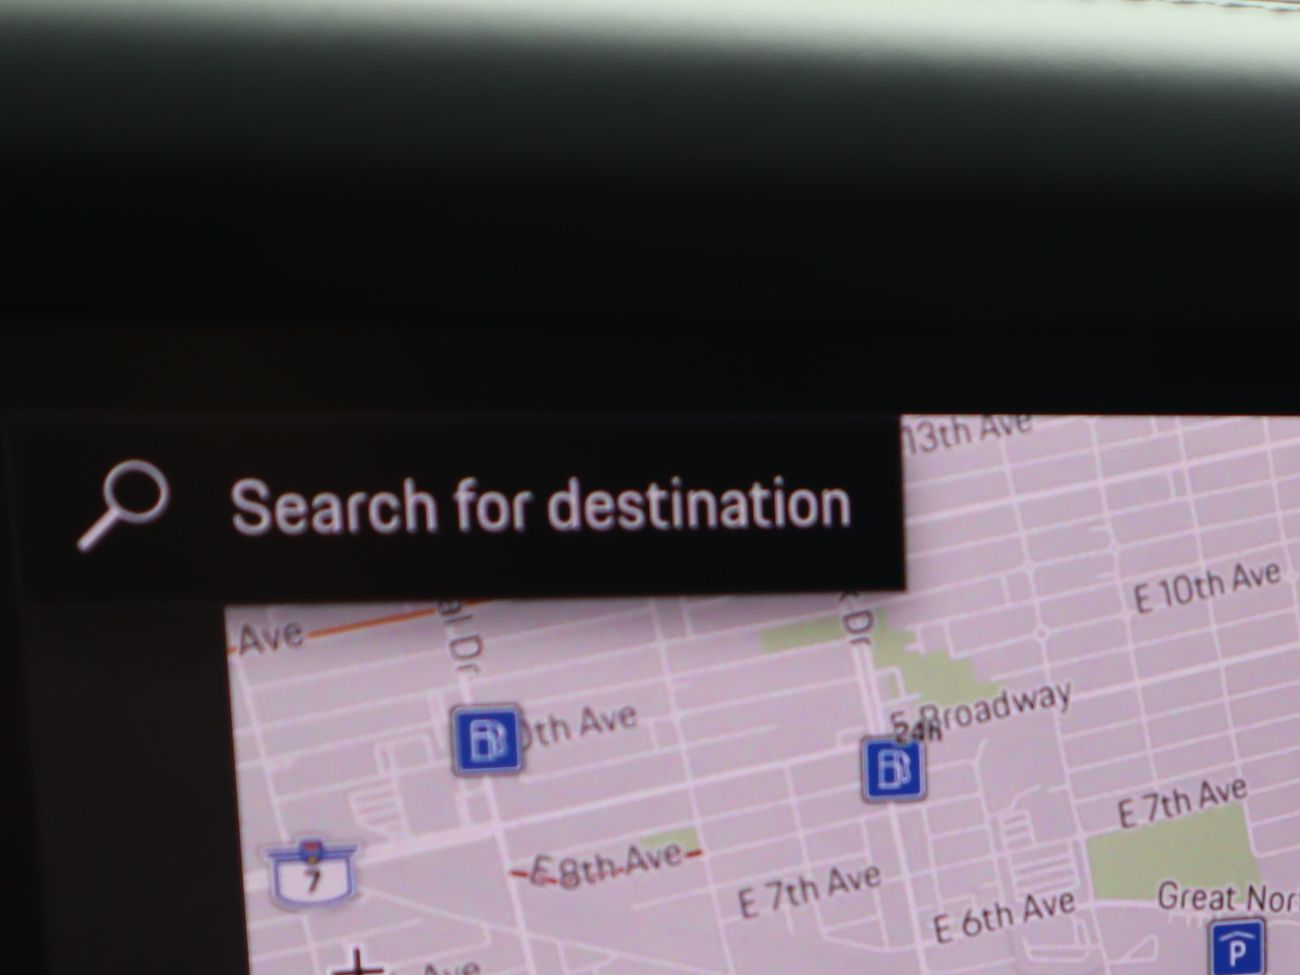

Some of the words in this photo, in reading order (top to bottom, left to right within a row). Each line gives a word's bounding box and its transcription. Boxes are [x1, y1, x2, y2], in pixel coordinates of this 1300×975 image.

[231, 478, 438, 535] Search
[454, 476, 533, 533] for
[548, 476, 851, 531] destination
[1135, 584, 1155, 614] E
[1161, 568, 1226, 605] 10th
[1233, 561, 1282, 591] Ave
[238, 619, 305, 656] Ave
[843, 609, 874, 645] Dr
[450, 635, 482, 673] Dr
[580, 705, 638, 735] Ave
[1117, 798, 1137, 829] E
[1145, 783, 1192, 823] 7th
[1199, 776, 1248, 808] Ave
[305, 869, 321, 893] 7
[530, 854, 551, 887] E
[623, 841, 683, 871] Ave
[738, 889, 759, 920] E
[766, 875, 819, 908] 7th
[828, 864, 882, 895] Ave
[1157, 880, 1237, 913] Great
[933, 915, 954, 944] E
[962, 901, 1014, 937] 6th
[1023, 890, 1076, 920] Ave
